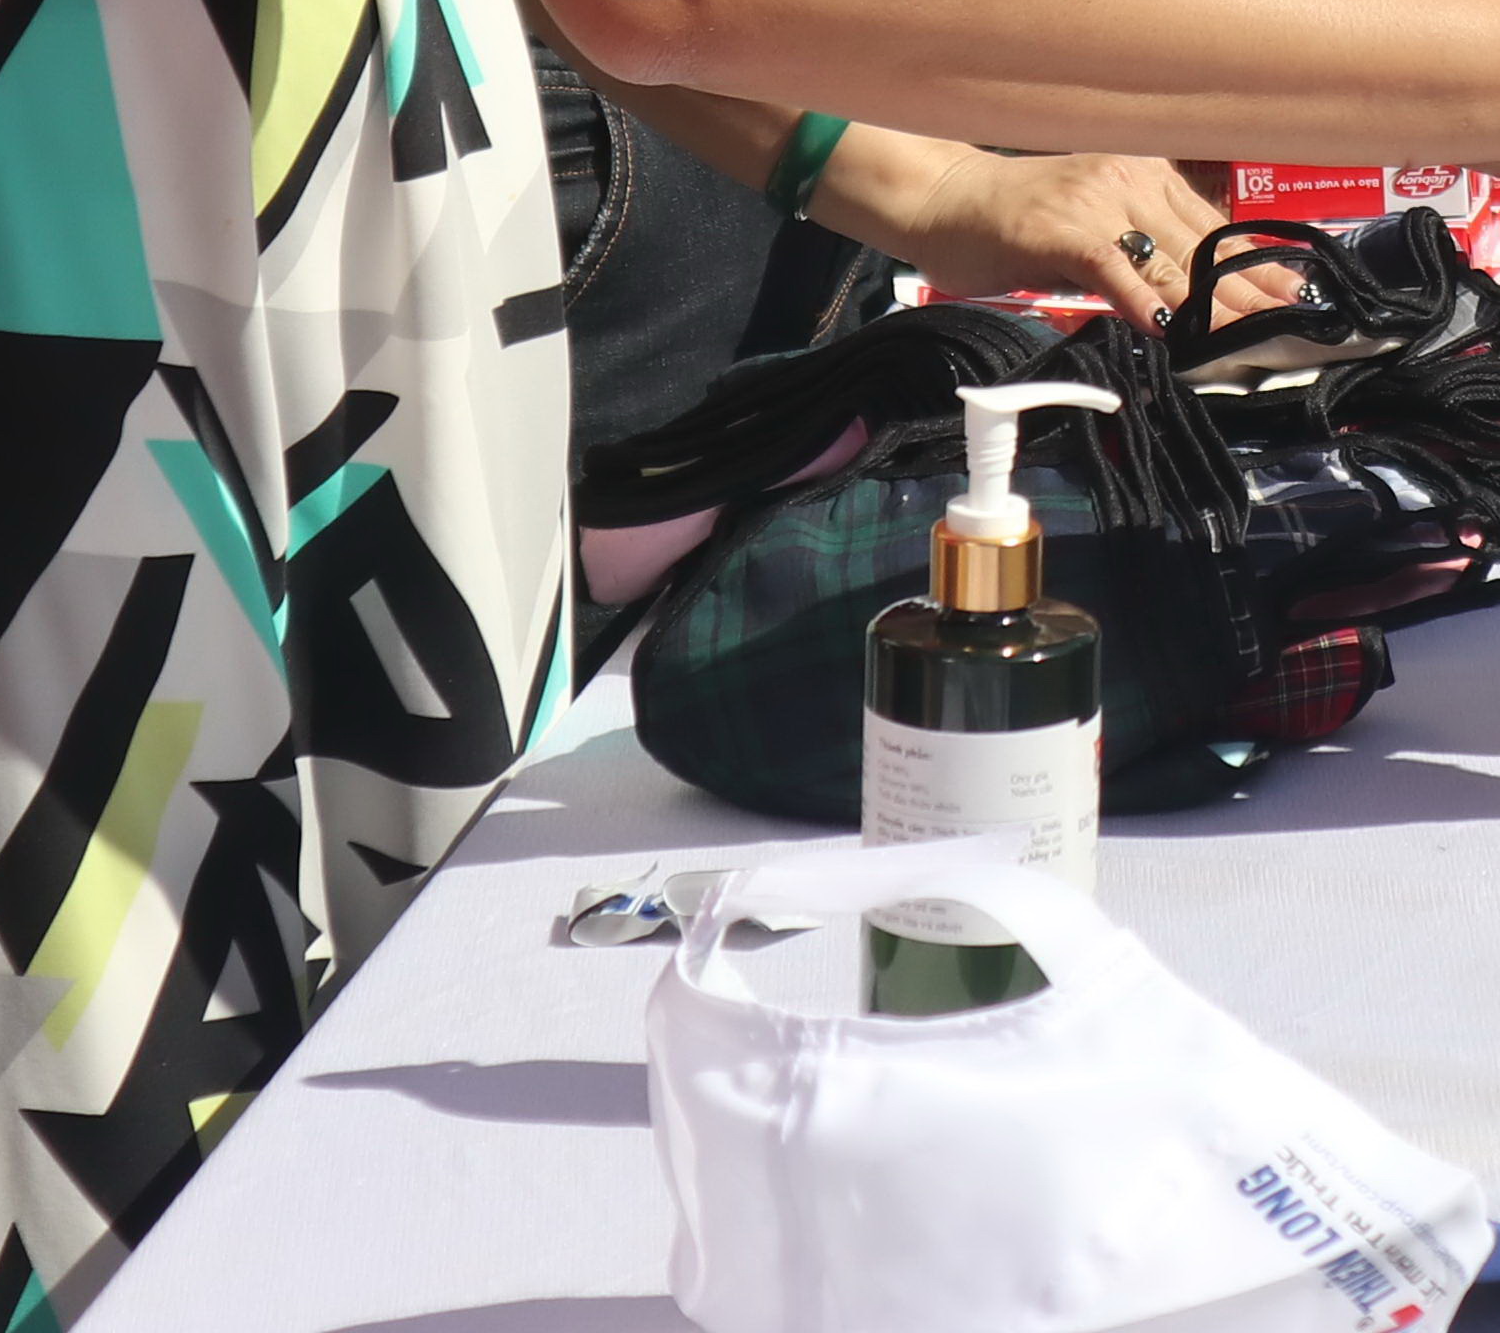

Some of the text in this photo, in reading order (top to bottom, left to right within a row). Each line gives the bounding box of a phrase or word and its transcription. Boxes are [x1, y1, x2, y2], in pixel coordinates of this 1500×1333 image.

[1278, 178, 1380, 192] Bảo vệ vượt trội 10
[1236, 1164, 1343, 1256] LONG
